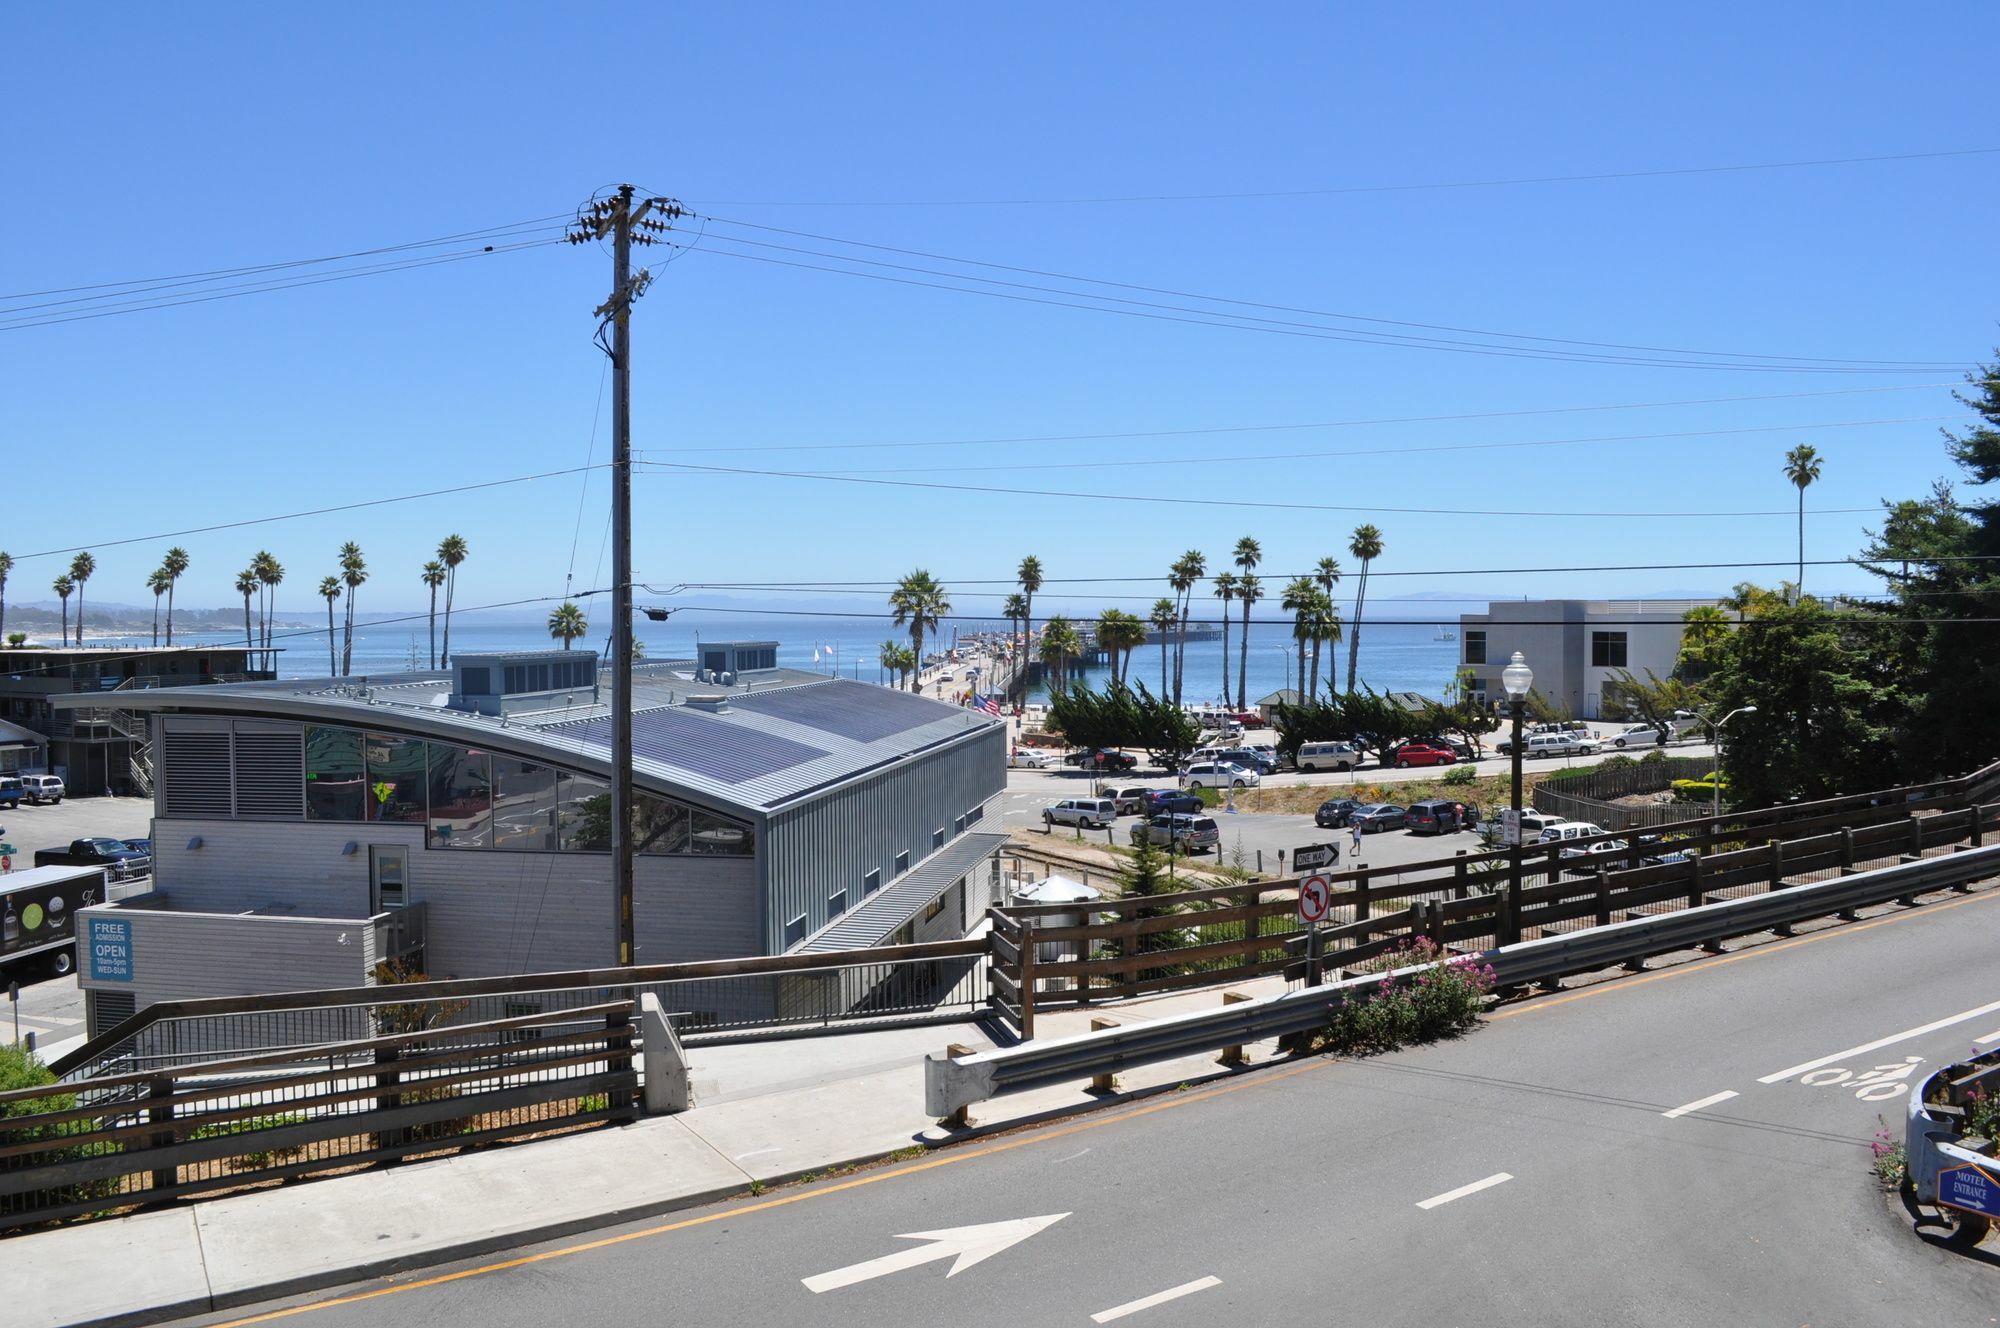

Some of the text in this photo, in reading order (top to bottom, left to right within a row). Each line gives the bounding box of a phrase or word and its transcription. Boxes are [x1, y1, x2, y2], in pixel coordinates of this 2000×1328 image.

[1298, 851, 1325, 864] ONE WAY
[95, 923, 125, 934] FREE
[95, 934, 126, 942] ADMISSION
[96, 945, 126, 958] OPEN
[97, 966, 127, 975] WED-SUN
[1955, 1171, 1986, 1187] MOTEL
[1953, 1181, 1987, 1200] ENTRANCE
